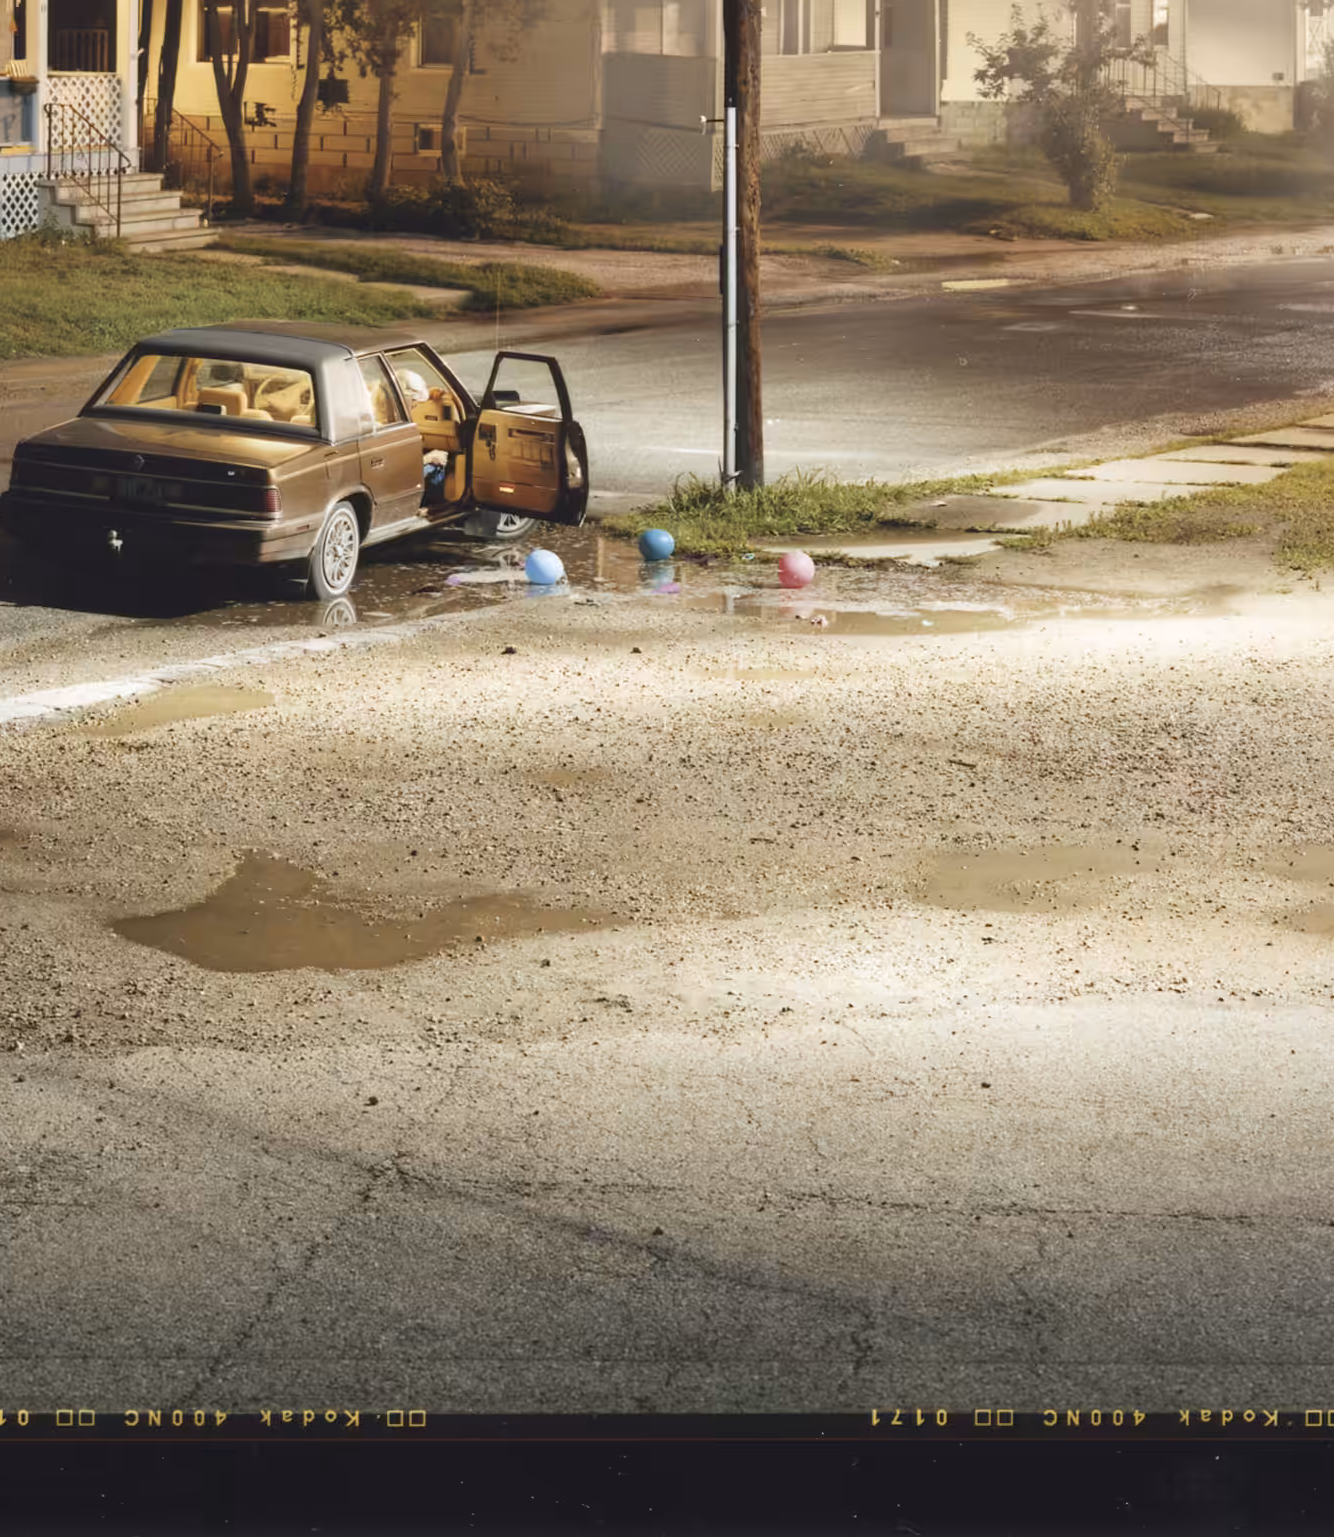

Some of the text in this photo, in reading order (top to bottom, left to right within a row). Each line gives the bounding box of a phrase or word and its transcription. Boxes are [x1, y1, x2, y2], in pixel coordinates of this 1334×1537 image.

[124, 1408, 228, 1427] 400NC
[260, 1408, 360, 1427] Kodak
[872, 1408, 1278, 1427] Kodak 400NC 0171
